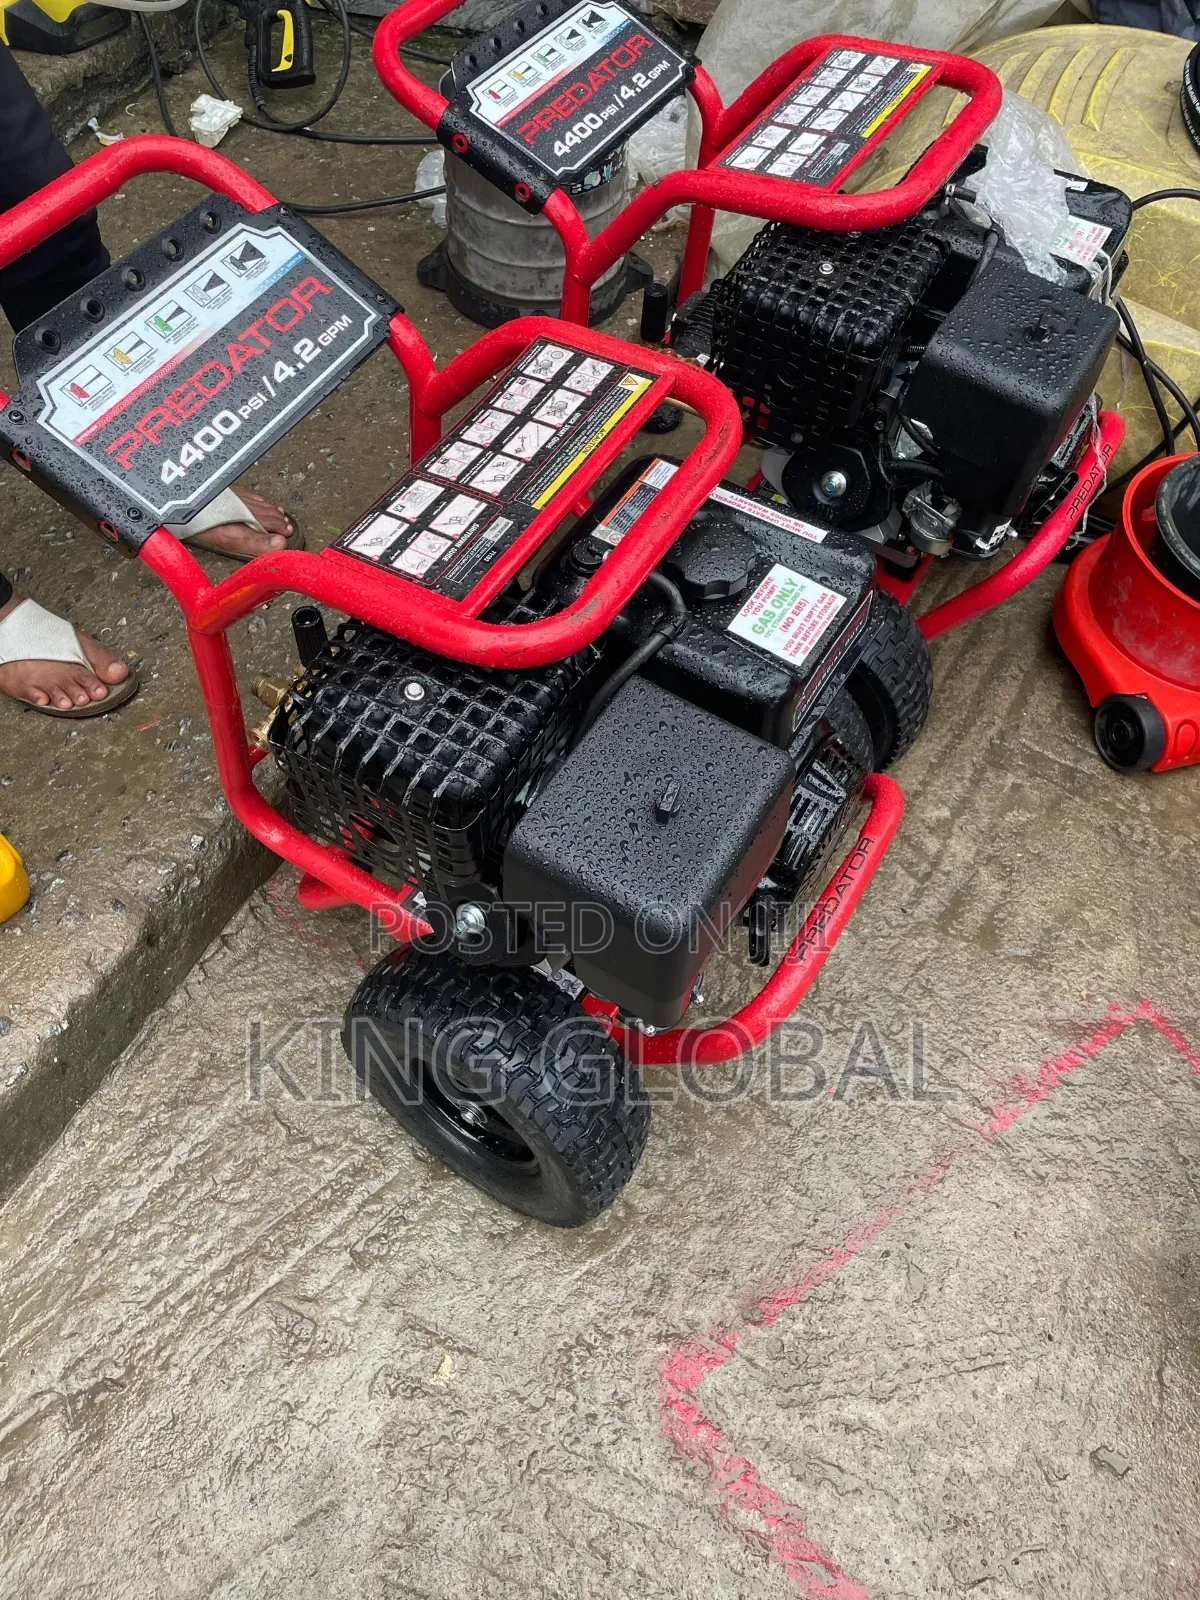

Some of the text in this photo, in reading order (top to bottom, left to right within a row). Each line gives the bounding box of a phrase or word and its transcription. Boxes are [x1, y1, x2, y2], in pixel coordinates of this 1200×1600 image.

[516, 34, 655, 145] PREDATOR
[553, 113, 602, 157] 4400
[600, 105, 619, 122] PSI
[620, 71, 651, 100] 4.2
[649, 61, 670, 80] GPM
[105, 274, 335, 471] PREDATOR
[161, 410, 241, 485] 4400
[238, 393, 266, 422] PSI
[273, 337, 322, 382] 4.2
[318, 315, 353, 346] GPM
[729, 495, 768, 513] WARRANTY
[747, 508, 778, 523] OPERATE
[770, 512, 791, 523] VOIDS
[781, 522, 801, 532] MUST
[455, 522, 479, 548] SHUTDOWN
[742, 576, 773, 617] LOOK BEFORE
[751, 577, 798, 636] GAS ONLY
[752, 584, 777, 616] YOU PUMP!
[780, 598, 808, 633] (NO E85)
[784, 592, 827, 651] YOU MUST EMPTY GAS
[790, 594, 837, 658] TANK BEFORE STORAGE
[793, 836, 875, 961] PREDATOR
